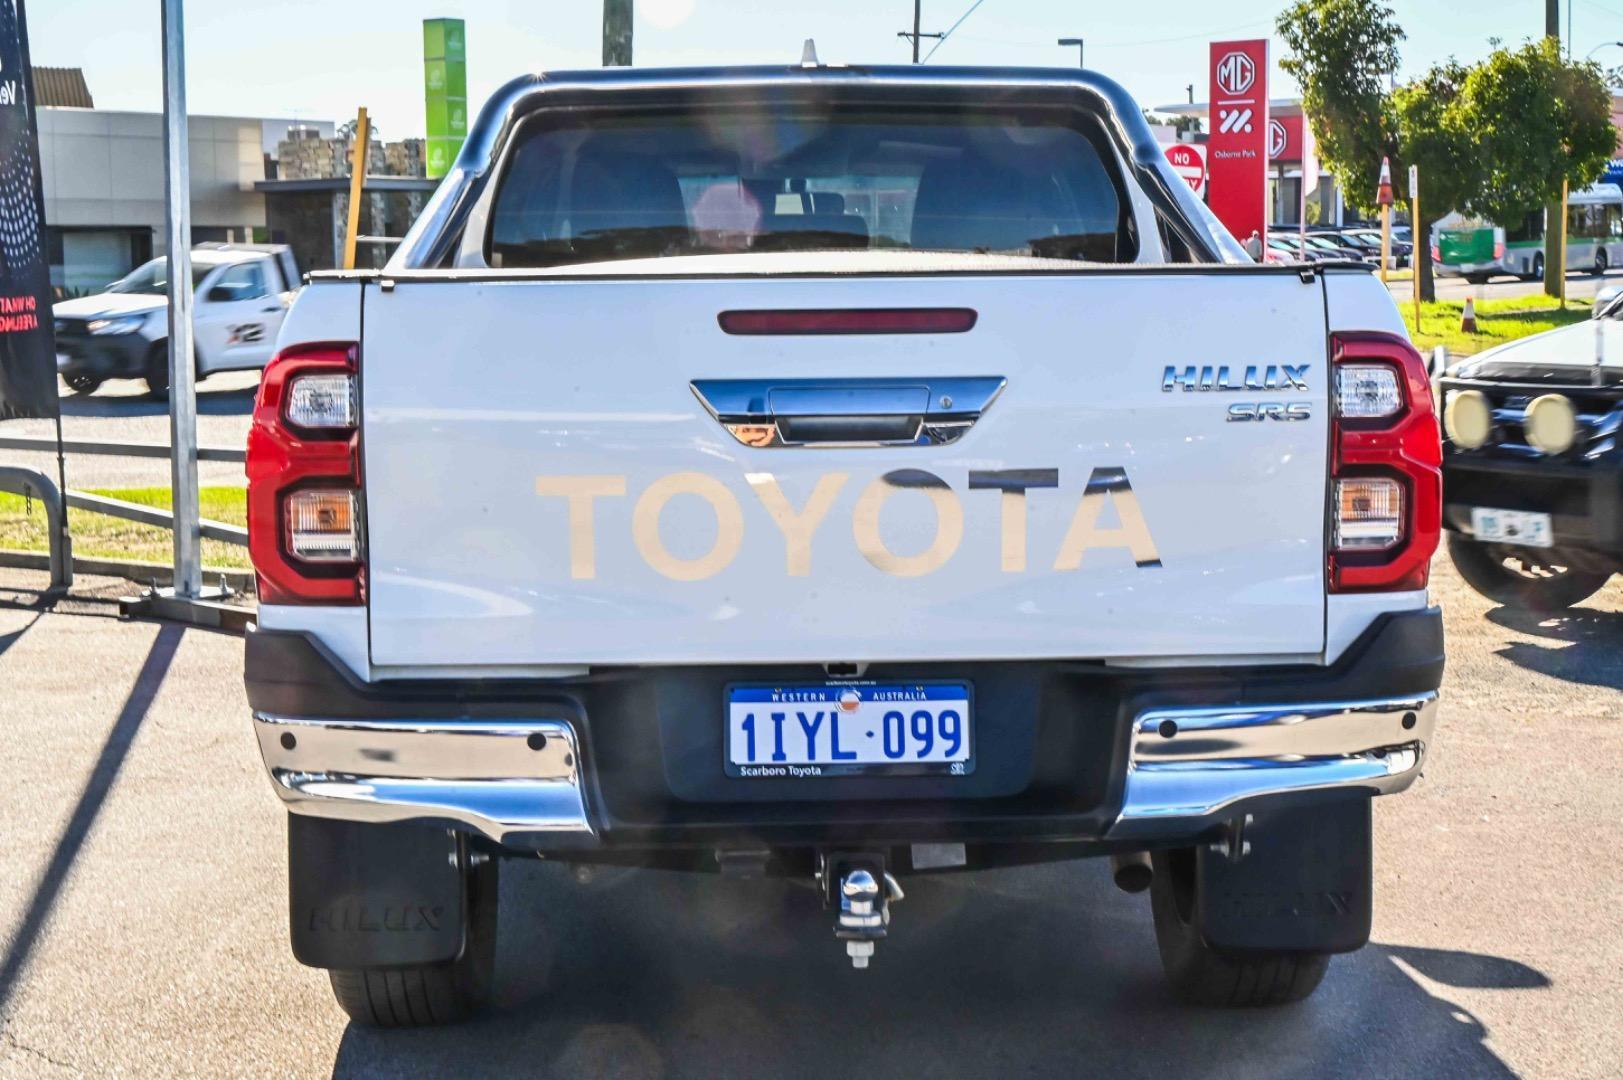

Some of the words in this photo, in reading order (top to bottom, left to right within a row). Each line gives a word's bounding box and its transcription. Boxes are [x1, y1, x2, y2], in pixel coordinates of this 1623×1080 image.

[1220, 55, 1252, 92] MG
[1174, 152, 1190, 165] NO
[1214, 150, 1240, 159] Osborne
[1162, 365, 1311, 392] HILUX
[535, 466, 1162, 582] TOYOTA
[772, 694, 826, 702] WESTERN
[872, 691, 927, 701] AUSTRALIA
[740, 766, 786, 776] Scarboro
[788, 765, 821, 777] Toyota
